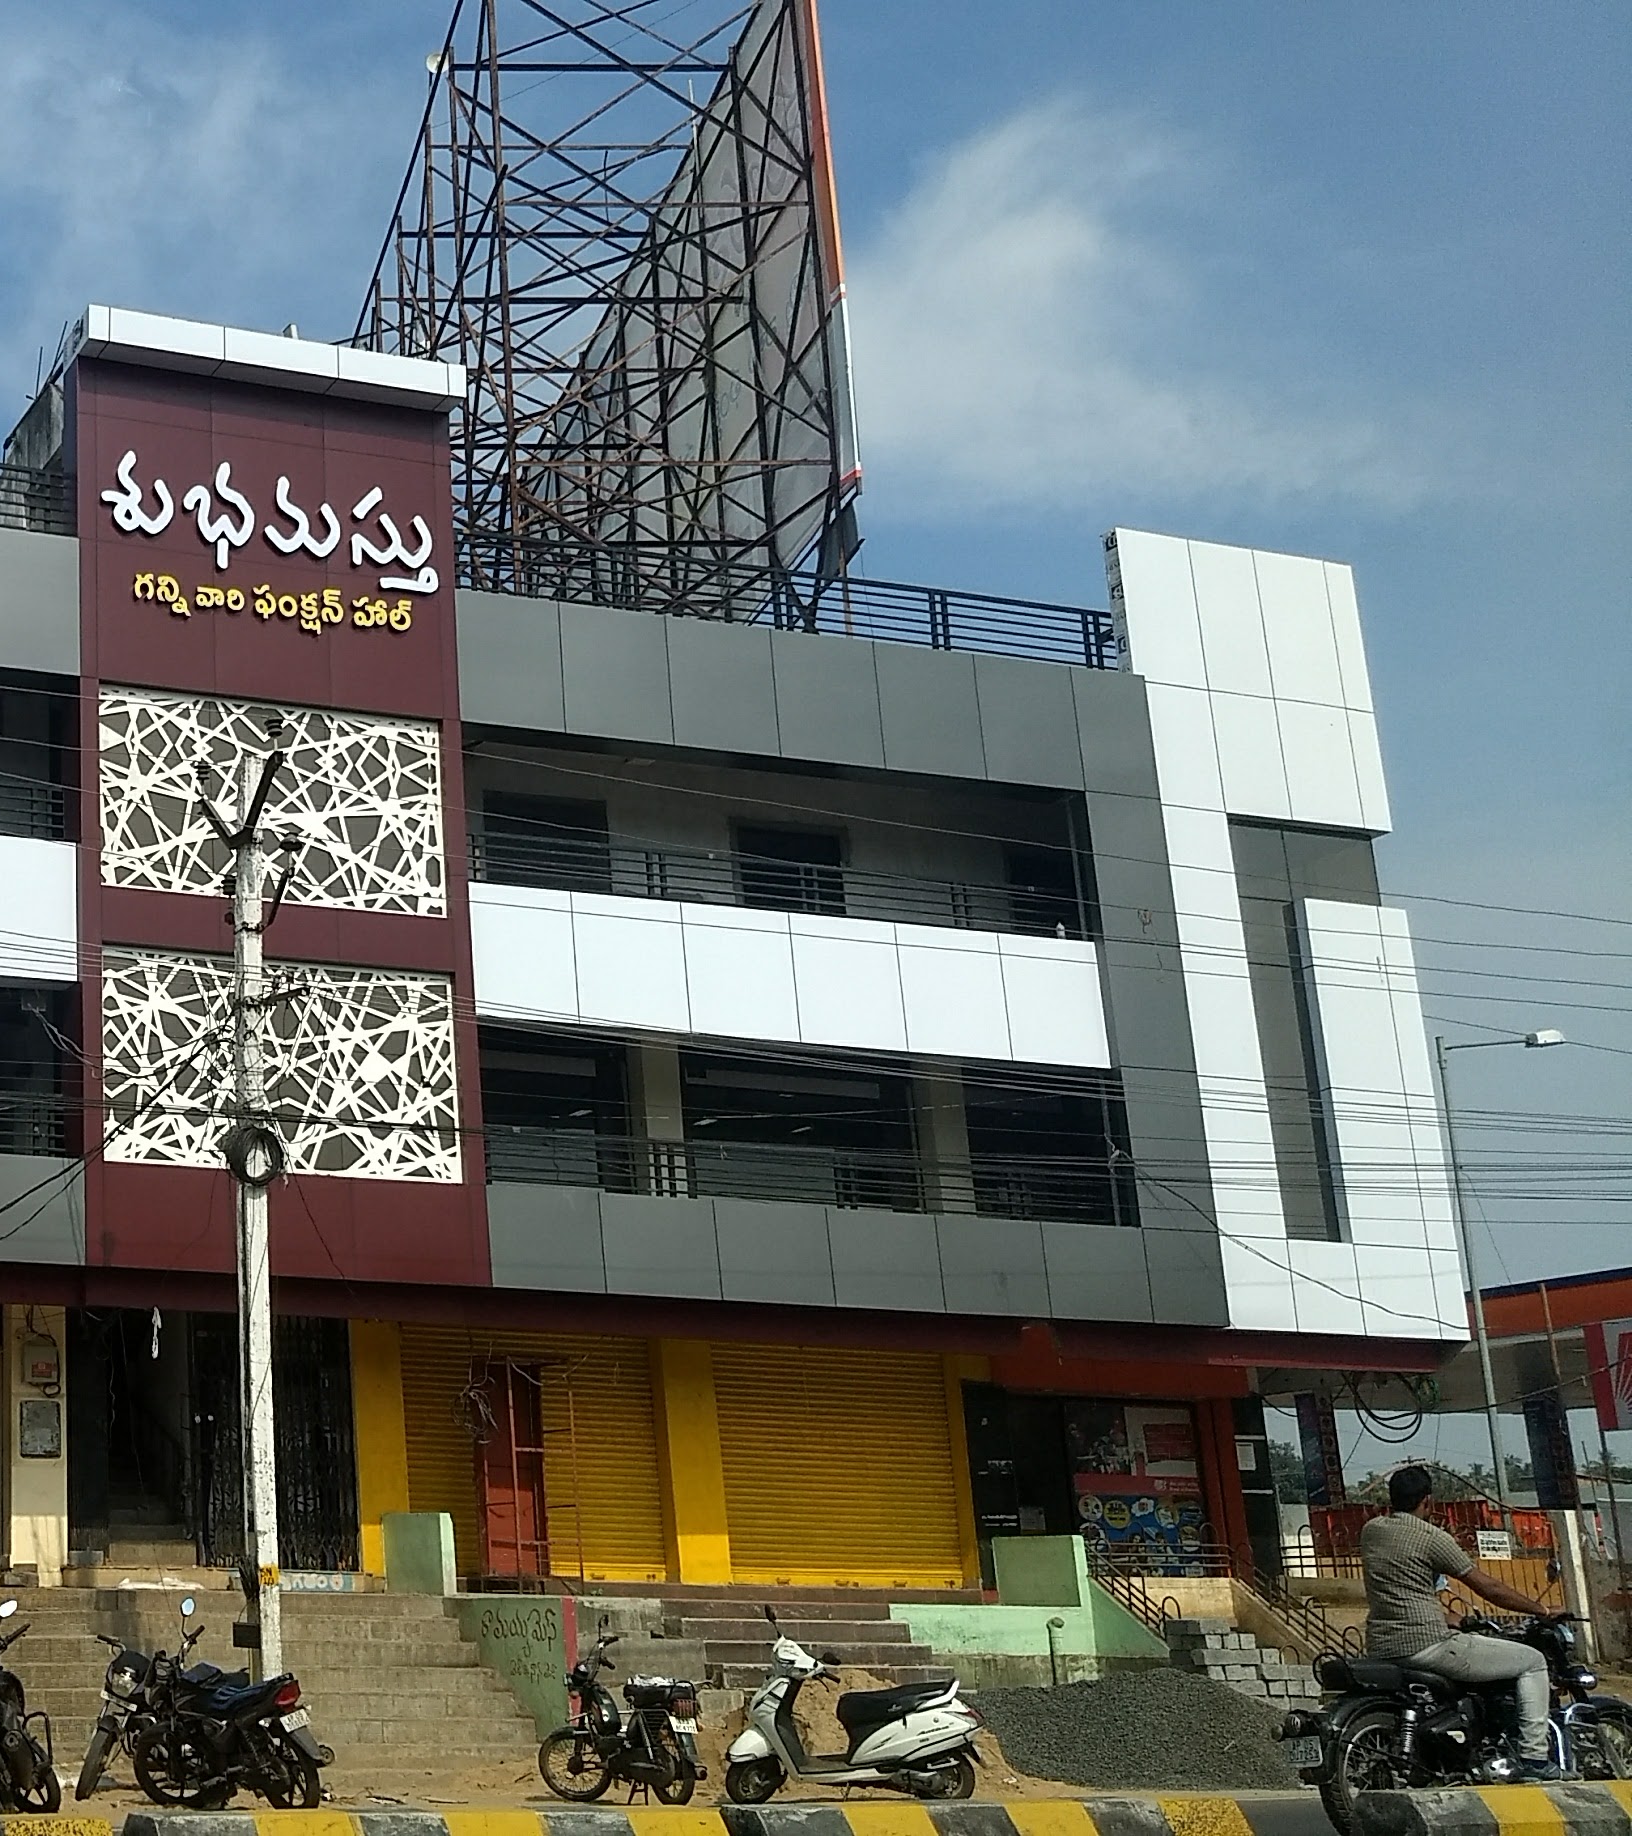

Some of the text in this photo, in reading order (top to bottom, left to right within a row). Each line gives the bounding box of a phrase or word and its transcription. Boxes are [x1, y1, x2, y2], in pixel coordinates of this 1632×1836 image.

[101, 450, 440, 593] శుభమస్తు
[134, 572, 413, 635] గన్ని వారి ఫంక్షన్ హాల్
